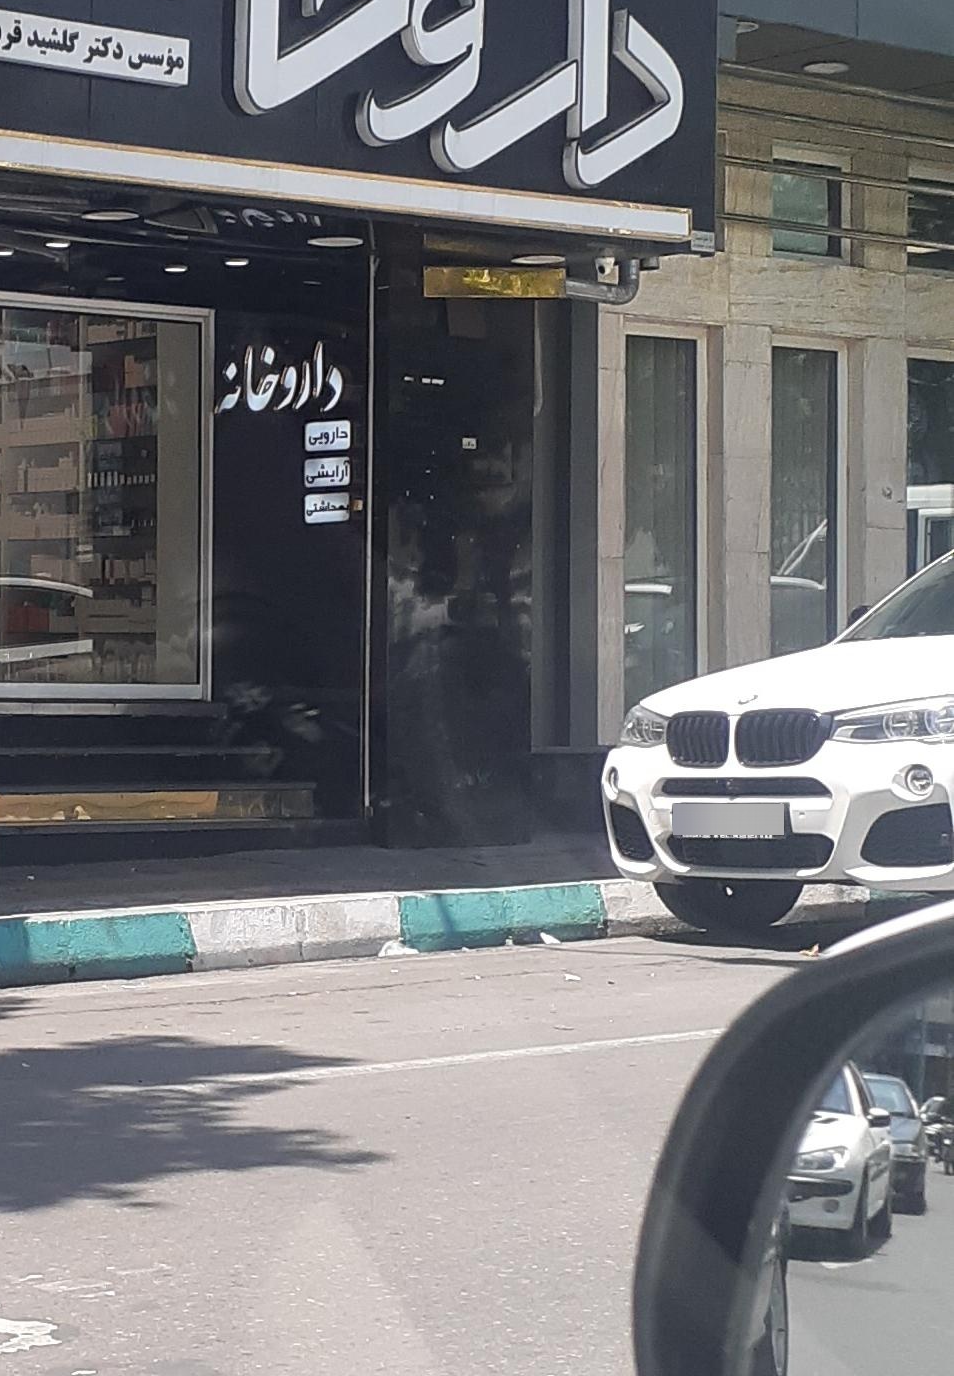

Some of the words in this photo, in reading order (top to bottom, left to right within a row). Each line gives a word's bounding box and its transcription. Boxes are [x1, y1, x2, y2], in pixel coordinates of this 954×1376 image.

[82, 35, 124, 64] دکتر
[214, 340, 344, 415] داروخانه
[306, 460, 350, 484] آرایشی
